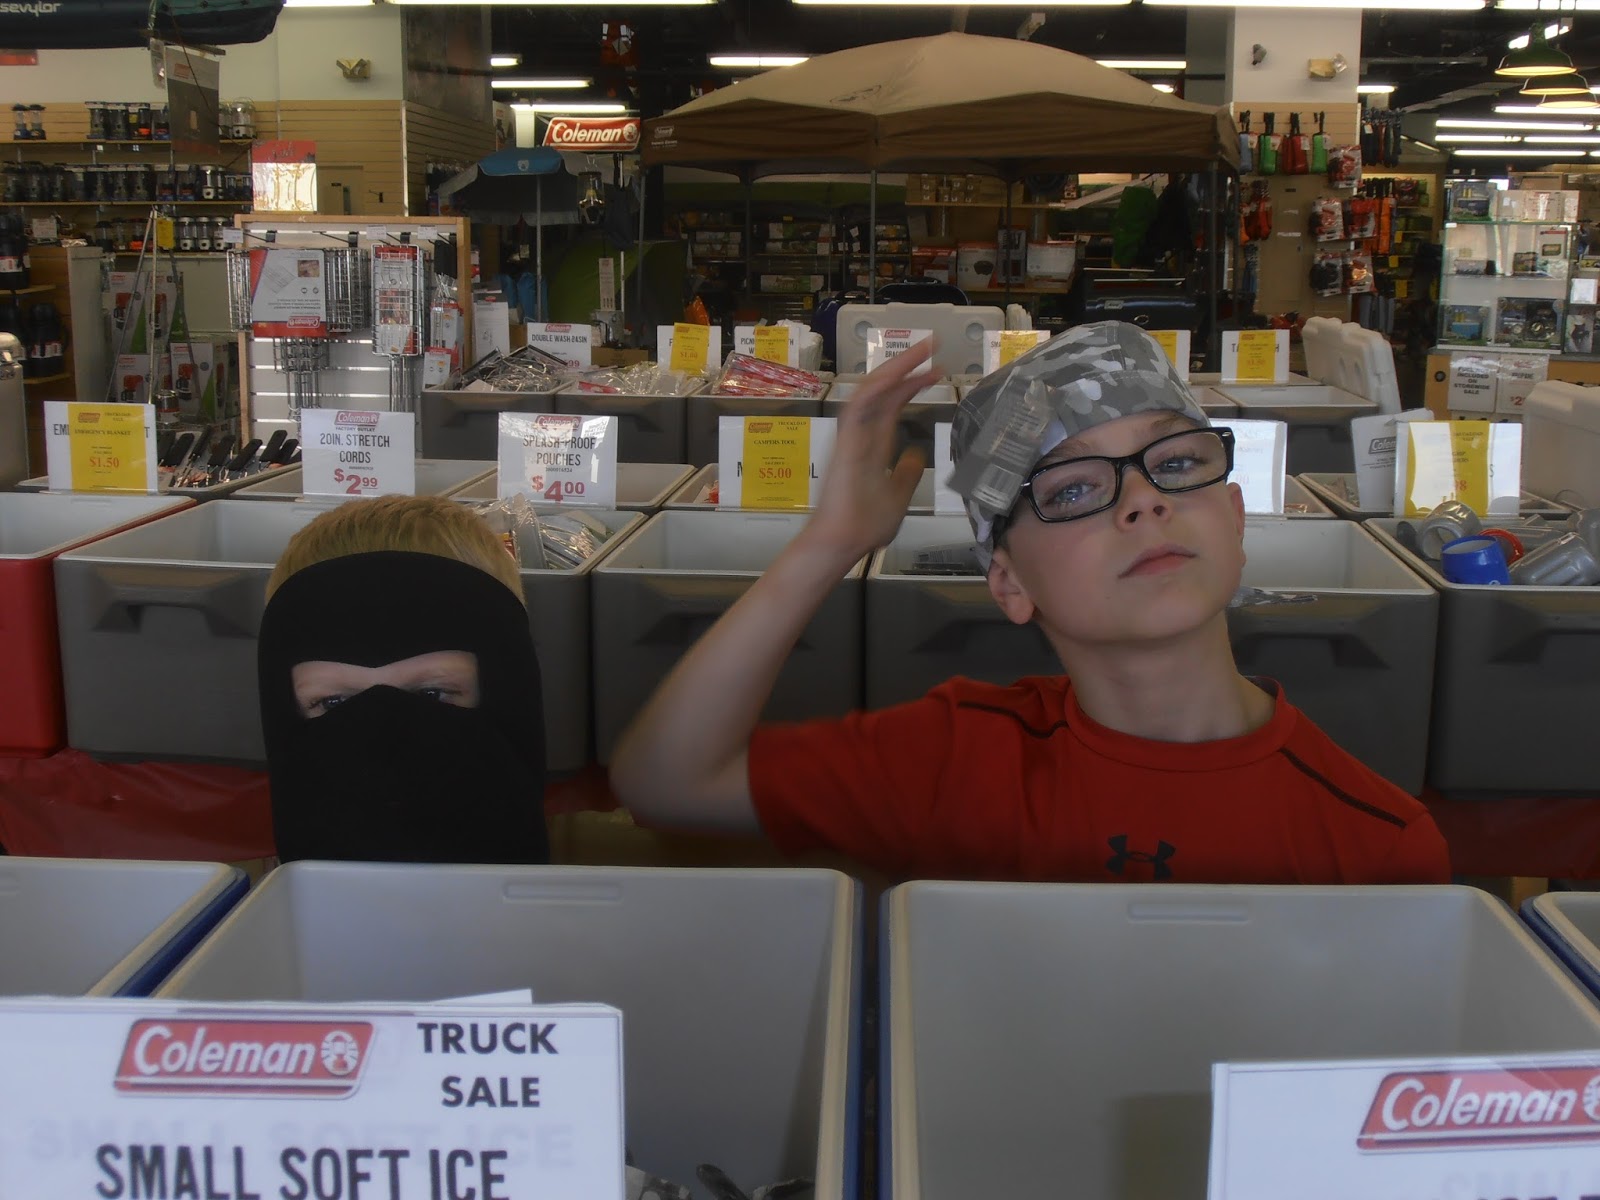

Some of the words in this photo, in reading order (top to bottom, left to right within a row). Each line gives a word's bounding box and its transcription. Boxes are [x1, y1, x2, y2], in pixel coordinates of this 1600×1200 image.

[551, 122, 623, 143] Coleman
[531, 334, 553, 342] DOUBLE
[553, 335, 571, 343] WASH
[571, 335, 588, 343] BASIN
[338, 411, 372, 425] Coleman
[320, 432, 344, 446] 20IN.
[345, 434, 391, 448] STRETCH
[522, 434, 597, 450] SPLASH-PROOF
[89, 456, 120, 469] $1.50
[339, 450, 372, 464] CORDS
[535, 451, 582, 467] POUCHES
[758, 467, 792, 480] $5.00
[416, 1022, 560, 1055] TRUCK
[132, 1024, 317, 1077] Coleman
[440, 1075, 541, 1108] SALE
[1381, 1076, 1579, 1133] Coleman
[95, 1142, 262, 1200] SMALL
[278, 1145, 411, 1200] SOFT
[428, 1148, 510, 1200] ICE
